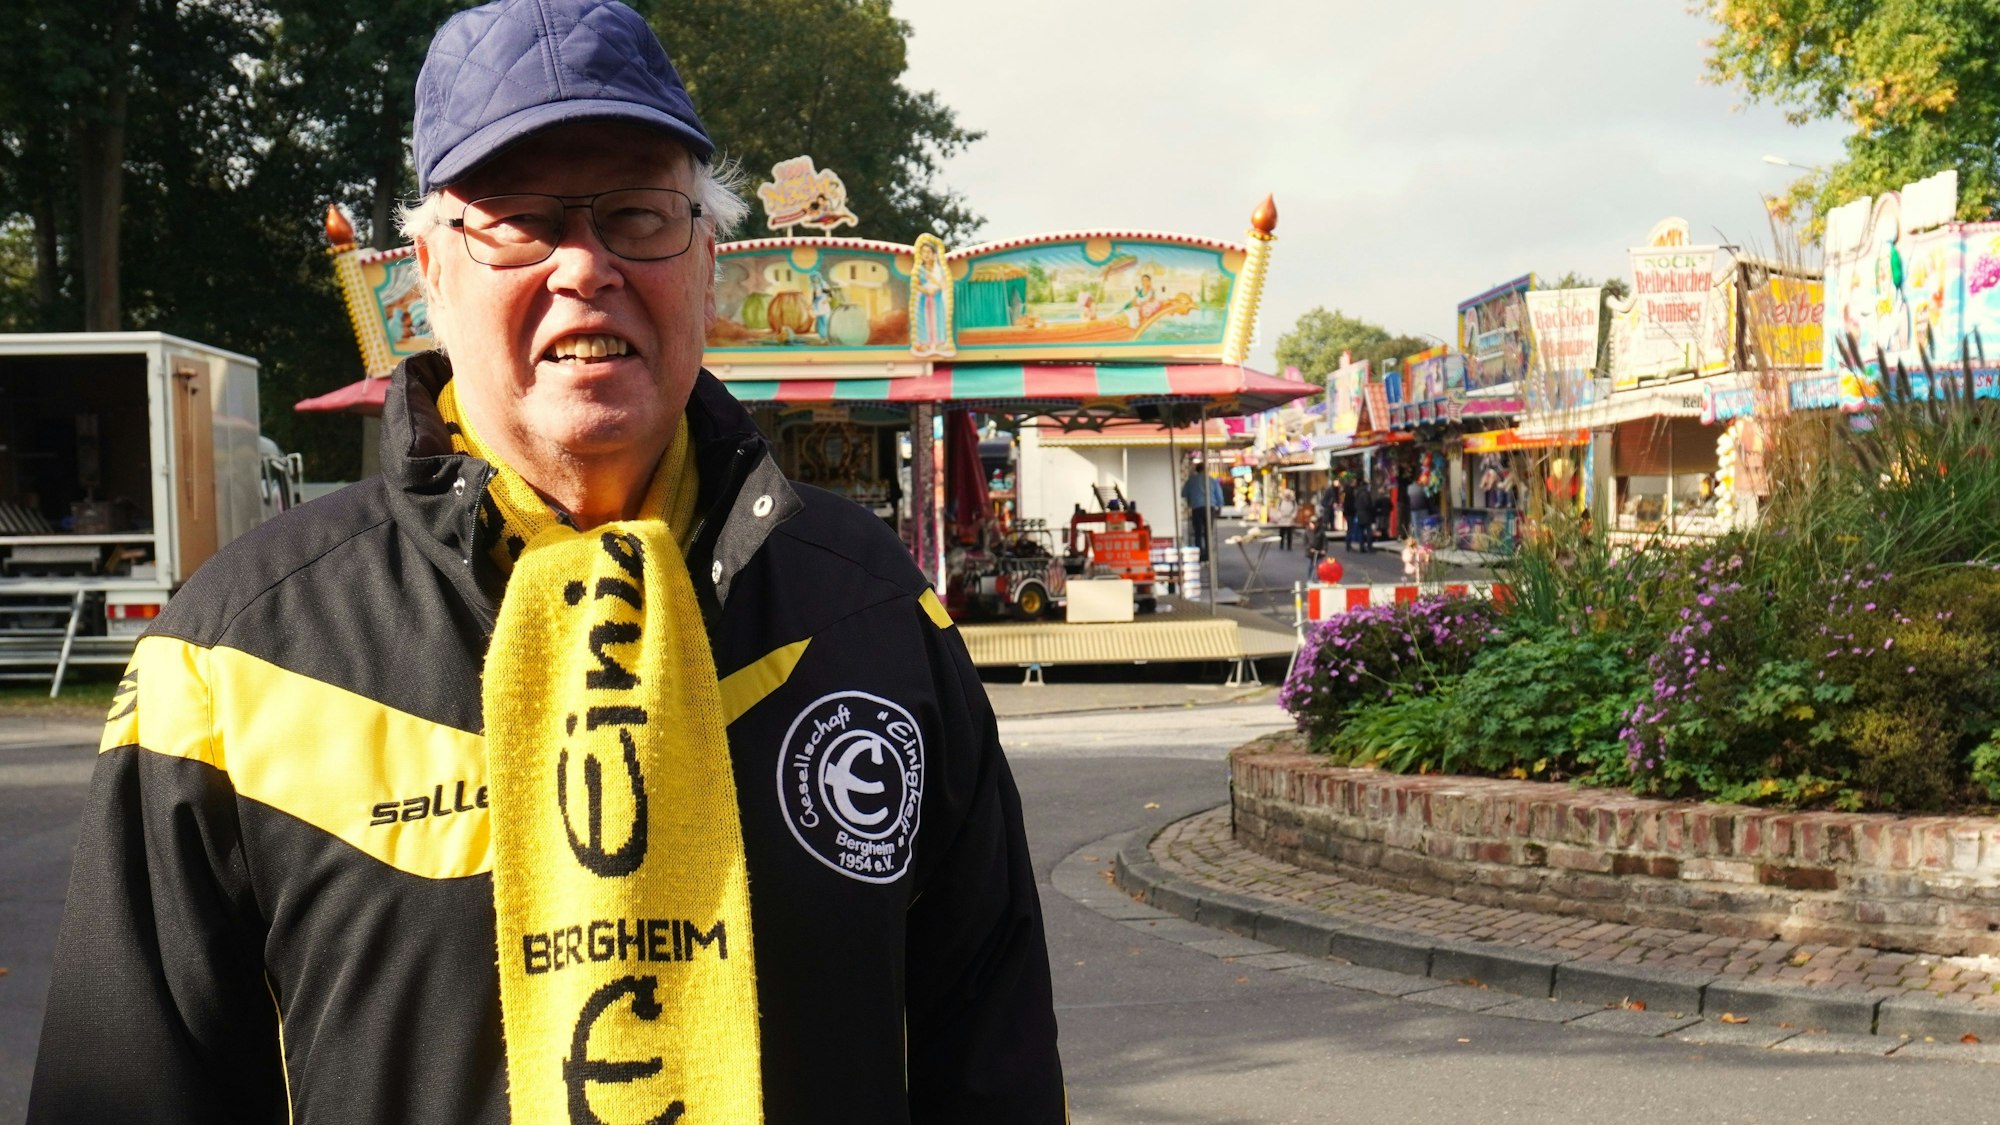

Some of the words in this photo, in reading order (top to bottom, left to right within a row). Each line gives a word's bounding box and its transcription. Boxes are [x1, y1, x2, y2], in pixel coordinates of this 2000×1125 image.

[1635, 269, 1713, 294] Reibekuchen
[1647, 299, 1702, 324] Pommes
[793, 703, 851, 828] Gesellschaft
[835, 830, 896, 857] Bergheim
[838, 852, 872, 872] 1954
[874, 854, 895, 872] e.V.
[524, 919, 728, 974] BERGHEIM
